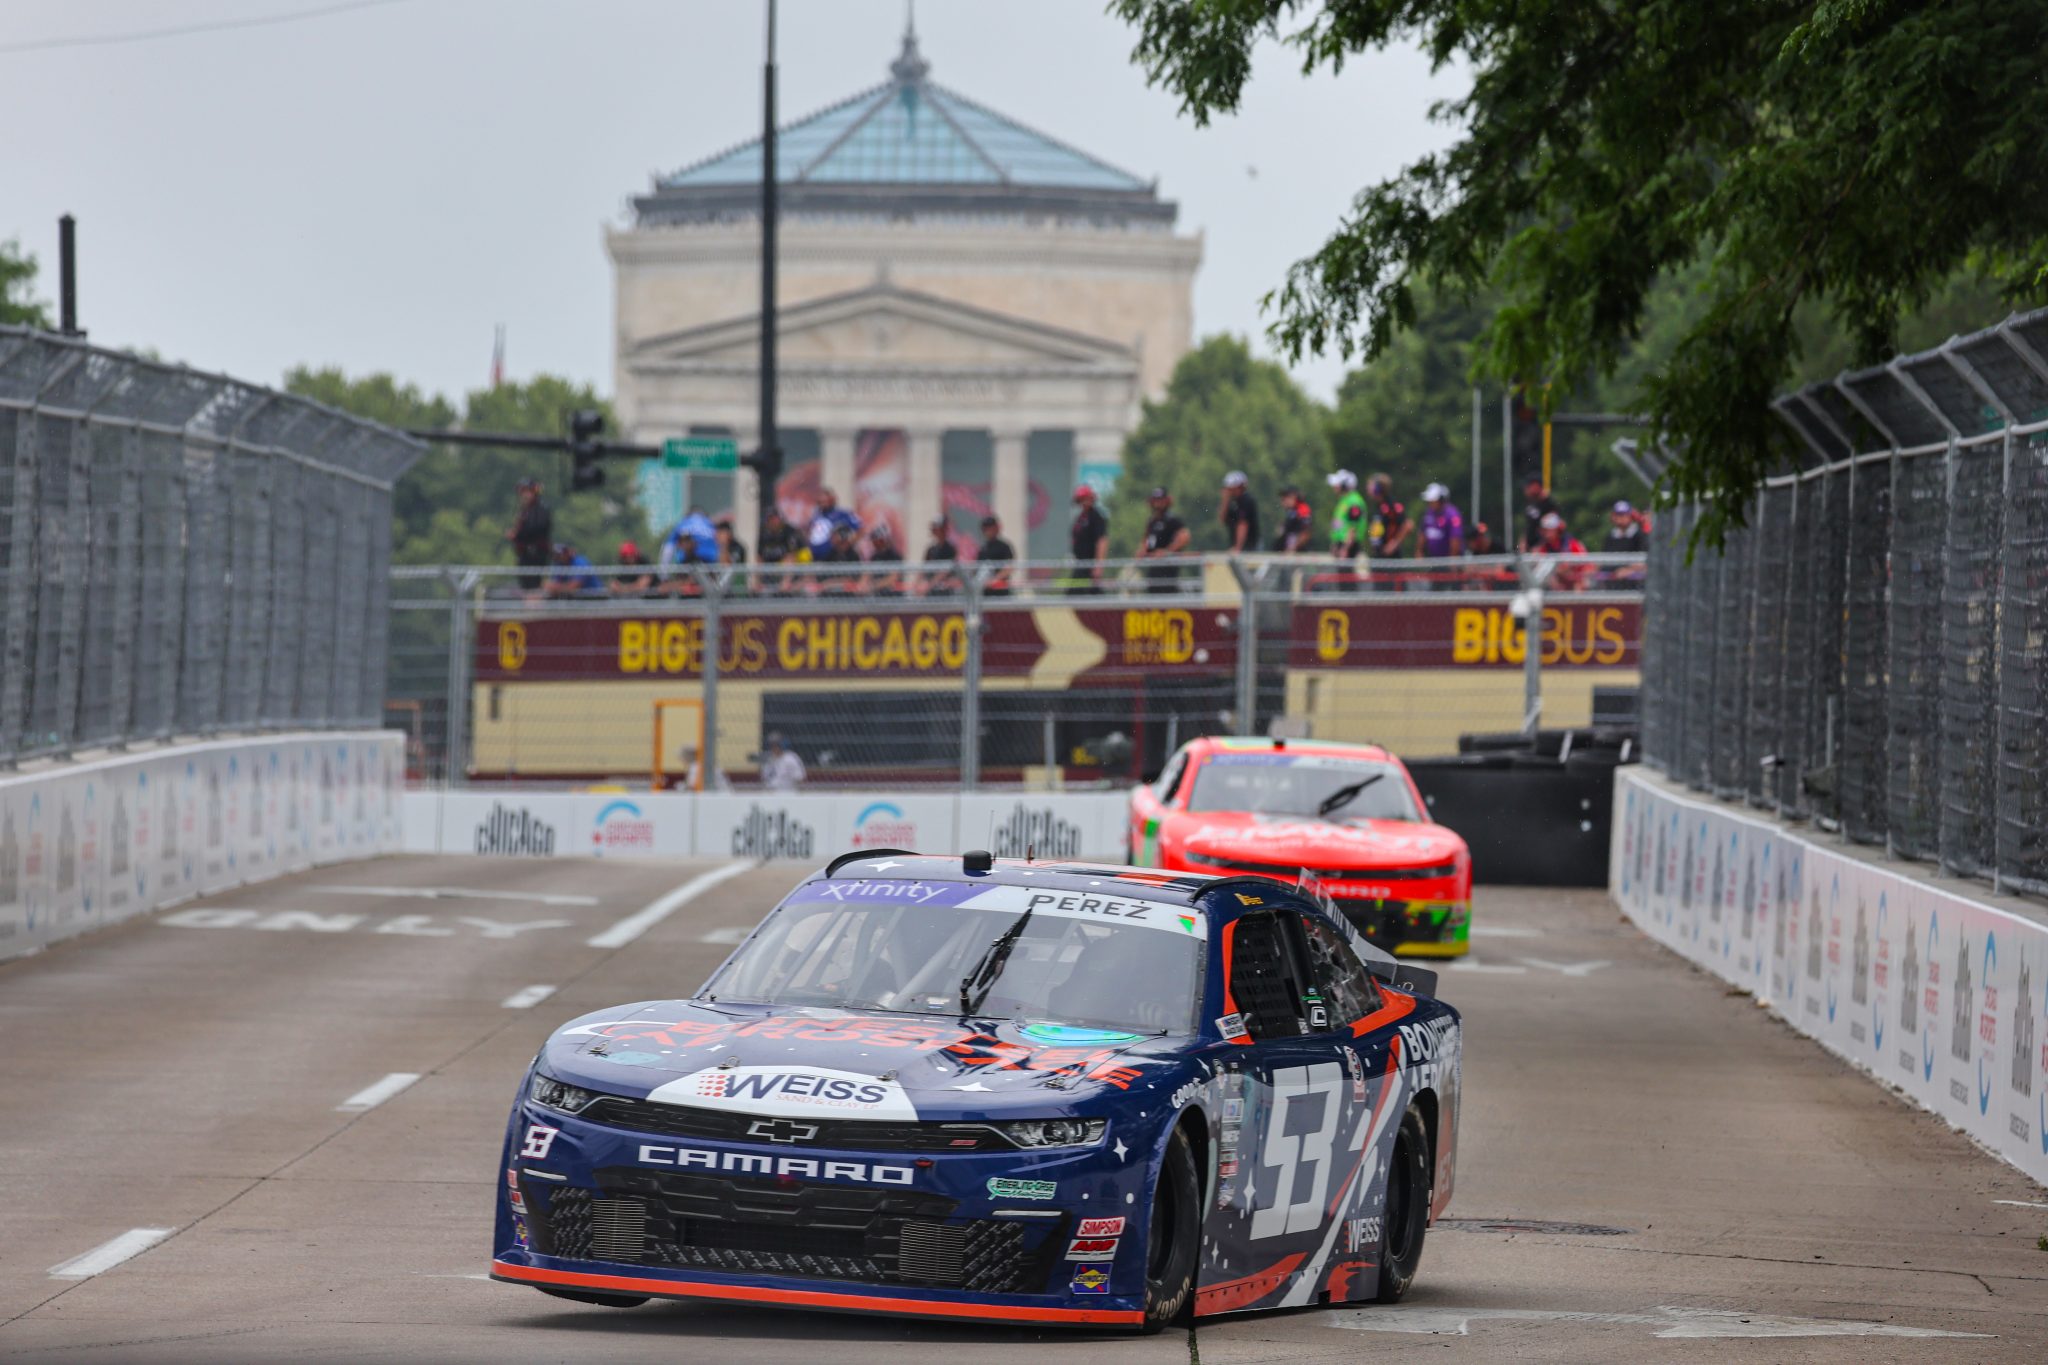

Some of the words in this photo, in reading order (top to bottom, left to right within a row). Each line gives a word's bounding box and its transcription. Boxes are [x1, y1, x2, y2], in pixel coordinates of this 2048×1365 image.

[777, 615, 968, 671] CHICAGO
[821, 880, 949, 904] xfinity
[1028, 894, 1152, 920] PEREZ
[724, 1074, 887, 1103] WEISS
[520, 1125, 559, 1159] 53
[1250, 1062, 1343, 1242] 53
[638, 1145, 914, 1185] CAMARO
[1081, 1220, 1122, 1235] SIMPSON
[1349, 1217, 1380, 1253] WEISS
